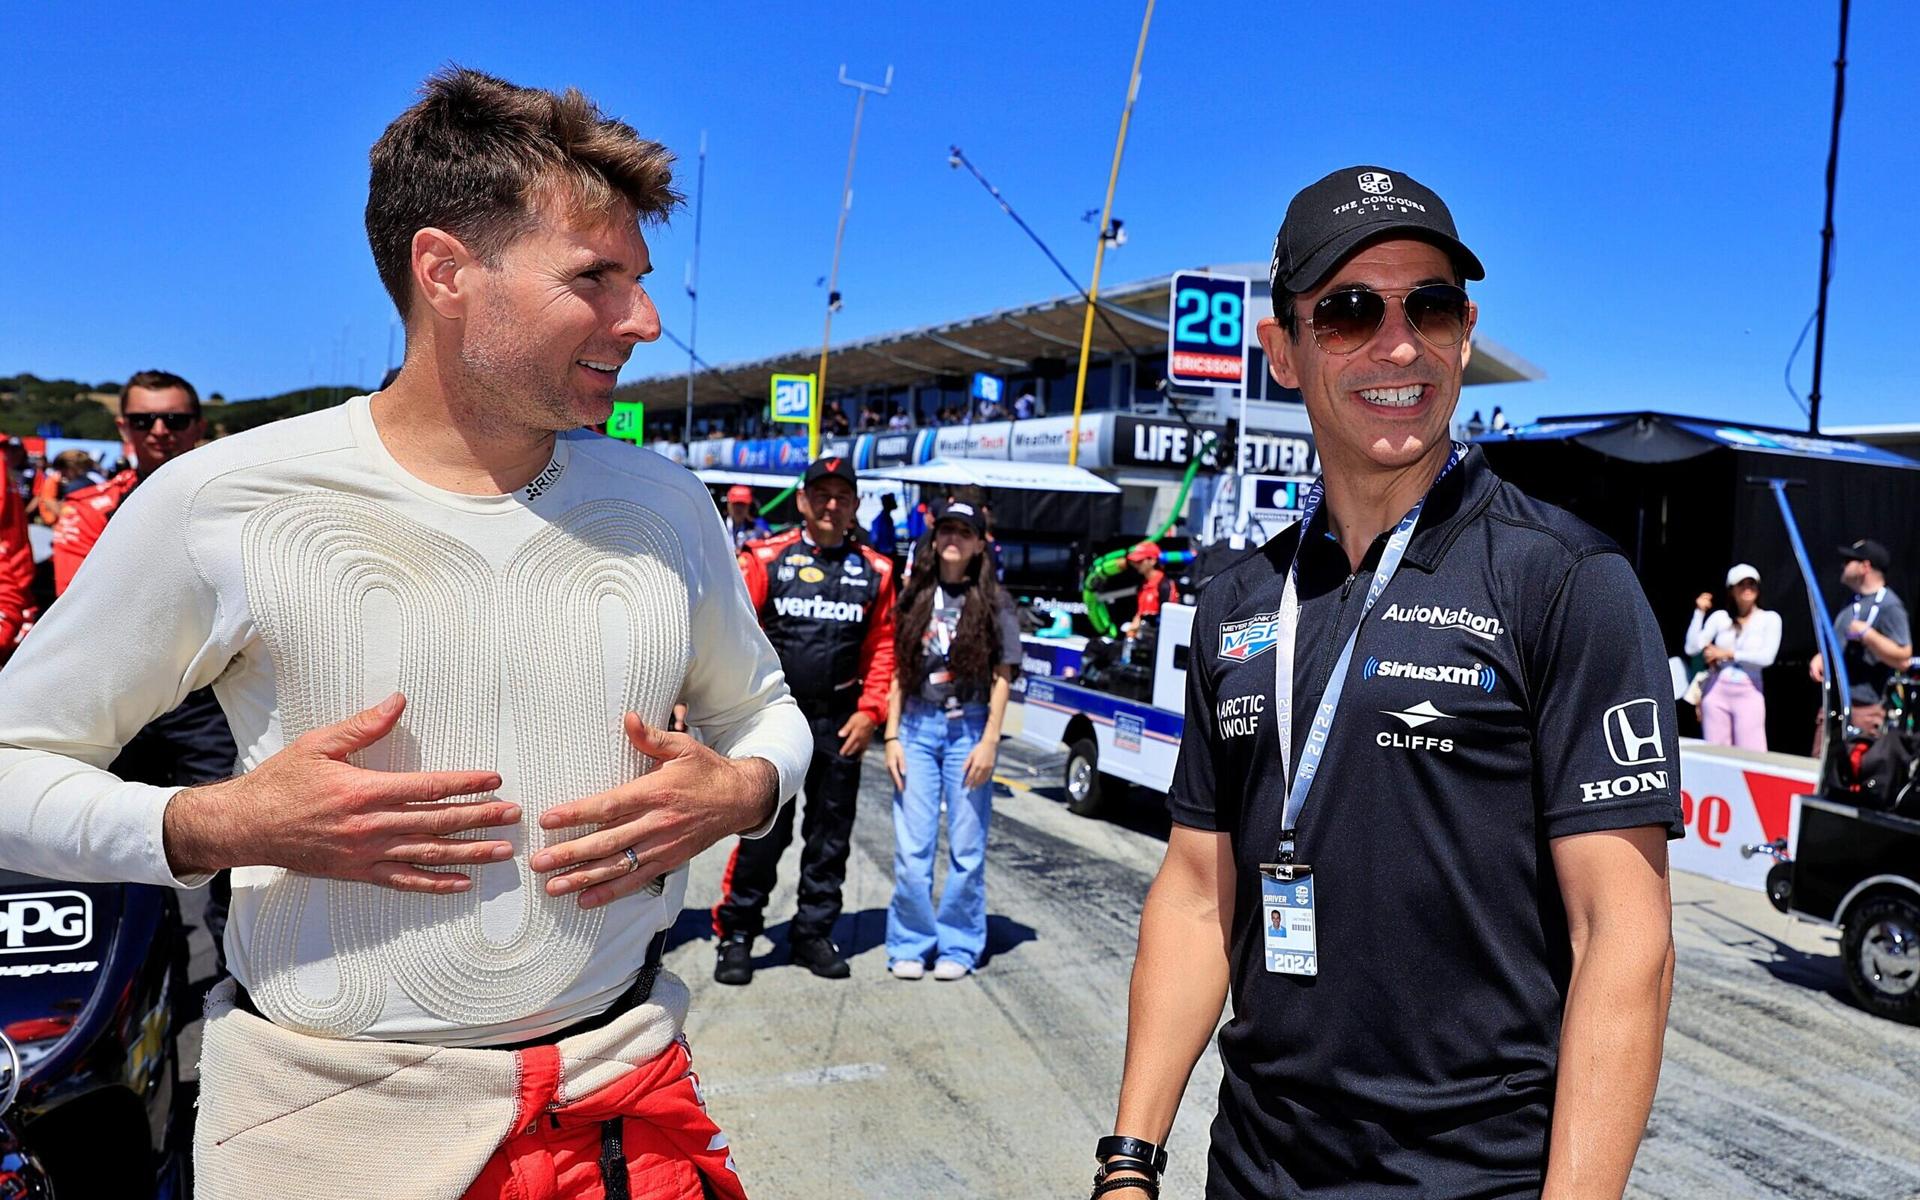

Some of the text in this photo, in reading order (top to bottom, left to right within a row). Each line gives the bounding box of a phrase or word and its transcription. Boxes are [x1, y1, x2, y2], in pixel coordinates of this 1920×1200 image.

[1333, 195, 1426, 215] THE CONCOURS
[1358, 204, 1408, 215] CLUB
[1176, 287, 1242, 347] 28
[1173, 355, 1242, 376] ERICSSON
[776, 382, 808, 415] 20
[615, 410, 633, 431] 21
[940, 435, 1005, 451] WeatherTech
[1015, 429, 1094, 449] WeatherTch
[1134, 423, 1188, 463] LIFE
[1235, 434, 1309, 473] ETTER
[534, 459, 561, 490] RINI
[1301, 479, 1324, 538] INDYC
[1390, 517, 1413, 550] NTT
[1363, 573, 1388, 615] 024
[773, 594, 864, 622] verizon
[1381, 603, 1500, 635] AutoNation
[1222, 622, 1248, 633] MEYER
[1247, 615, 1271, 627] SANK
[1220, 694, 1265, 719] ARCTIC
[1222, 715, 1259, 738] WOLF
[1279, 698, 1290, 750] 2024
[1308, 703, 1334, 756] 2024
[1376, 732, 1454, 753] CLIFFS
[1579, 770, 1670, 803] HON
[1264, 894, 1287, 904] DRIVER
[1274, 953, 1315, 974] 2024
